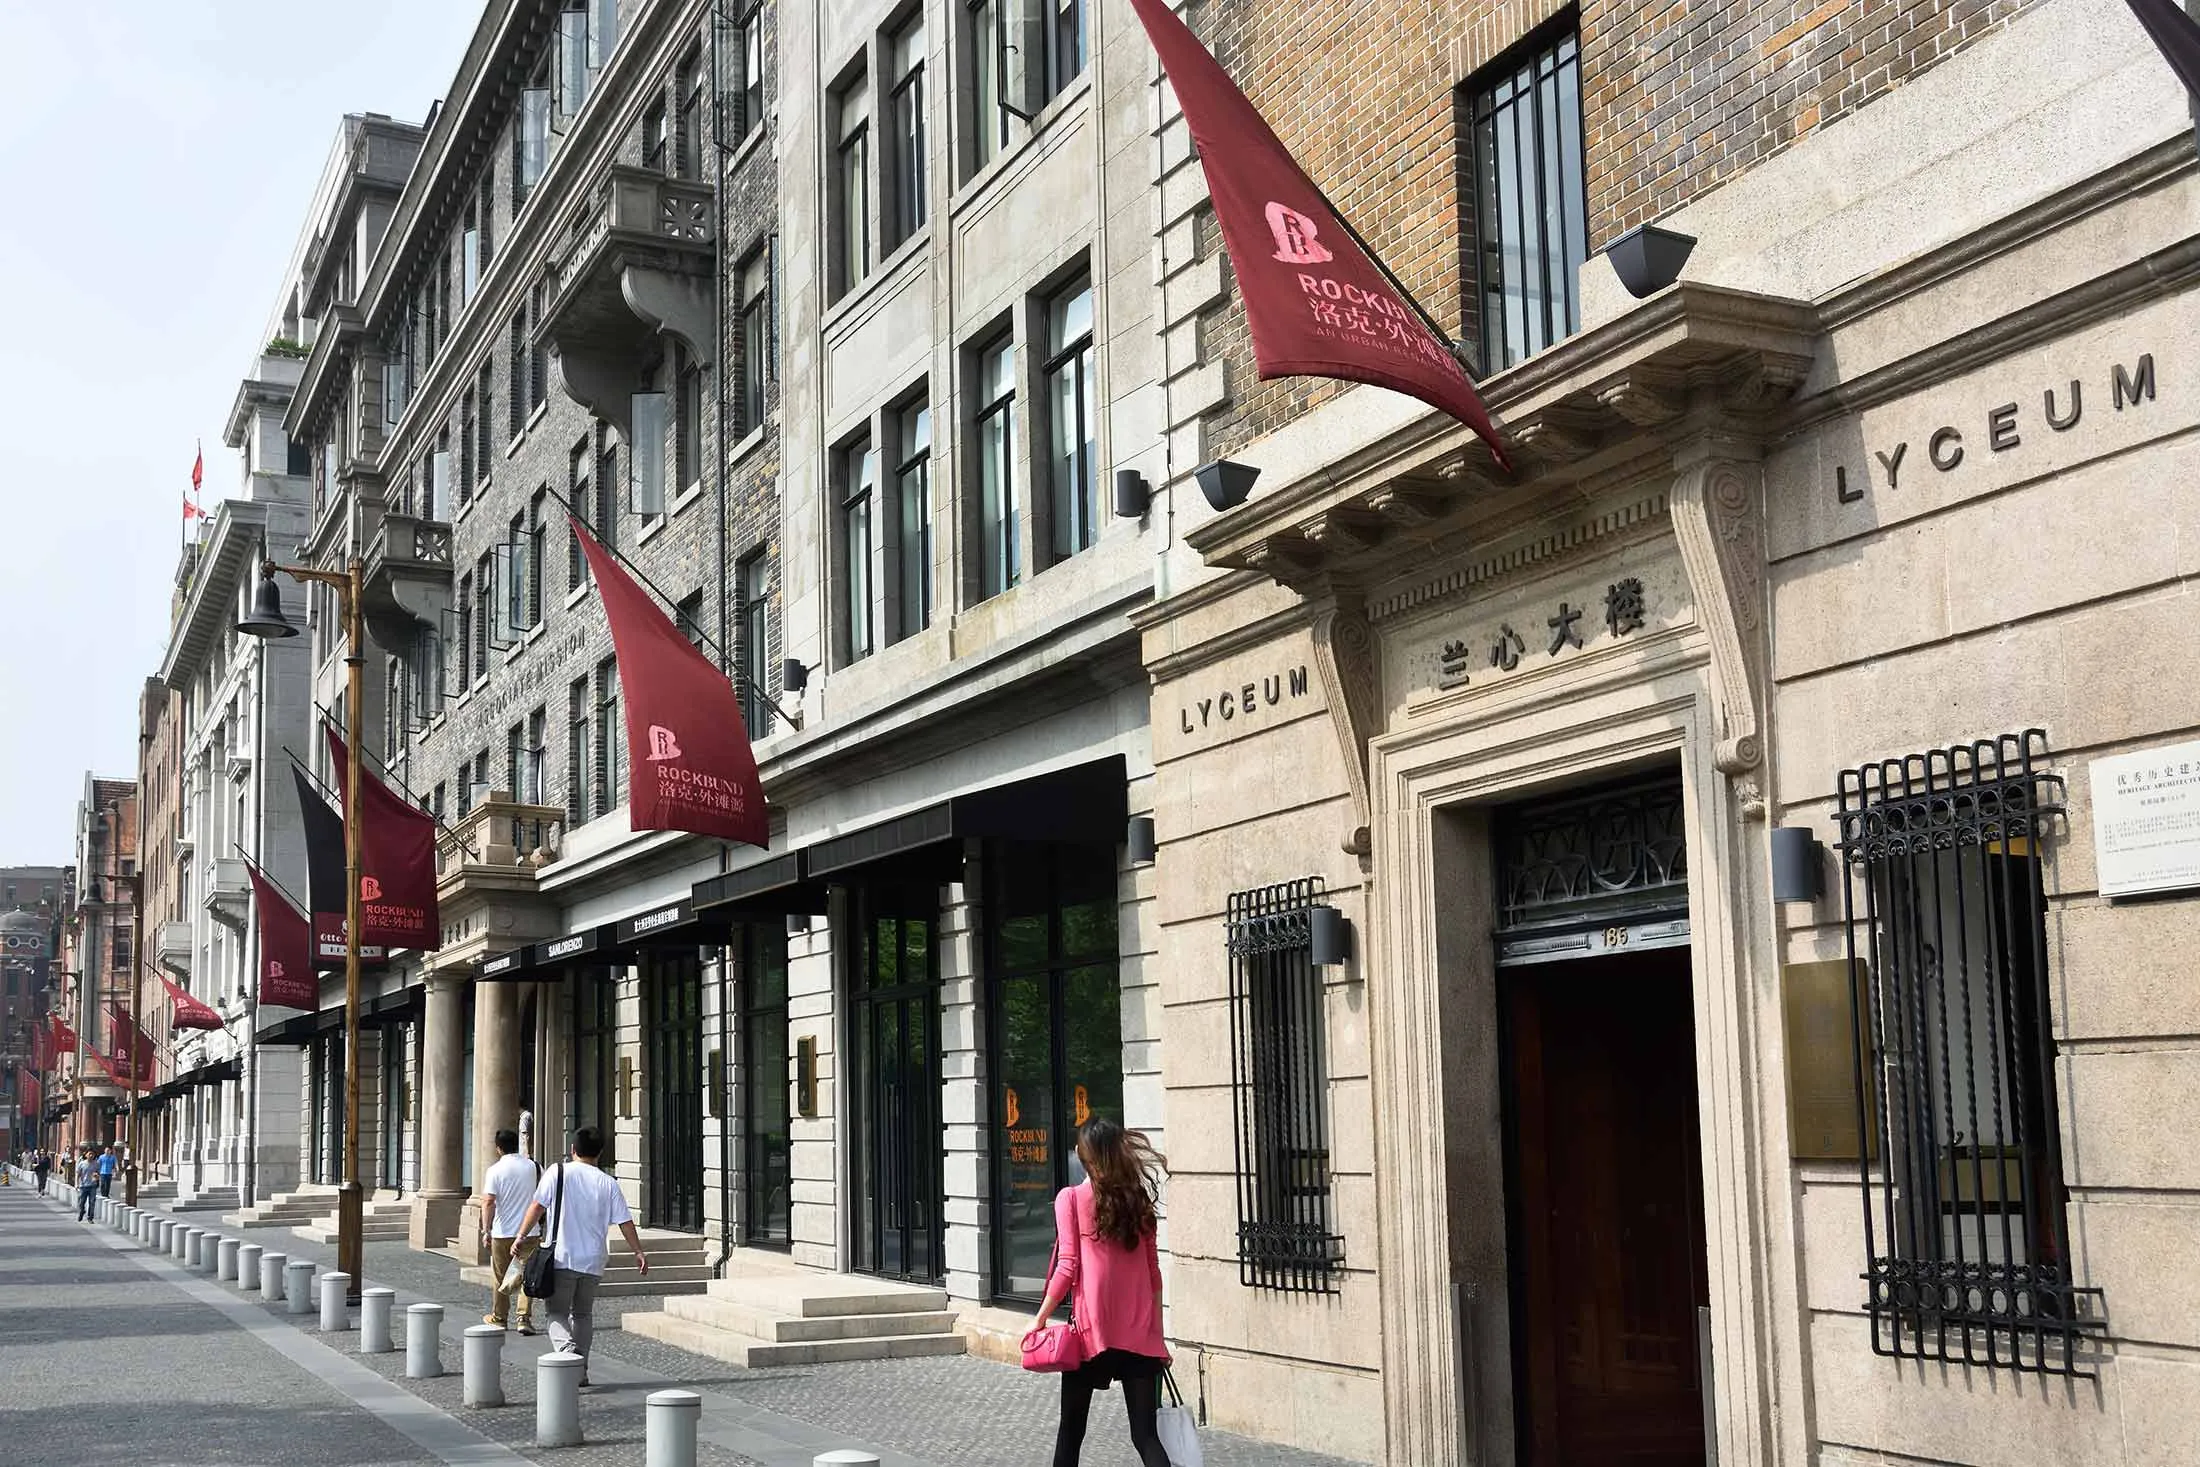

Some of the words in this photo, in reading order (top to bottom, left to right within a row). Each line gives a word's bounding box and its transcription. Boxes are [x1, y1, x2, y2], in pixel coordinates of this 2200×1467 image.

[1836, 353, 2157, 505] LYCEUM
[1439, 577, 1645, 690] 兰心大楼
[1181, 664, 1308, 734] LYCEUM
[657, 764, 743, 796] ROCKBUND
[658, 780, 744, 813] 洛克·外滩源
[320, 932, 343, 943] Otto
